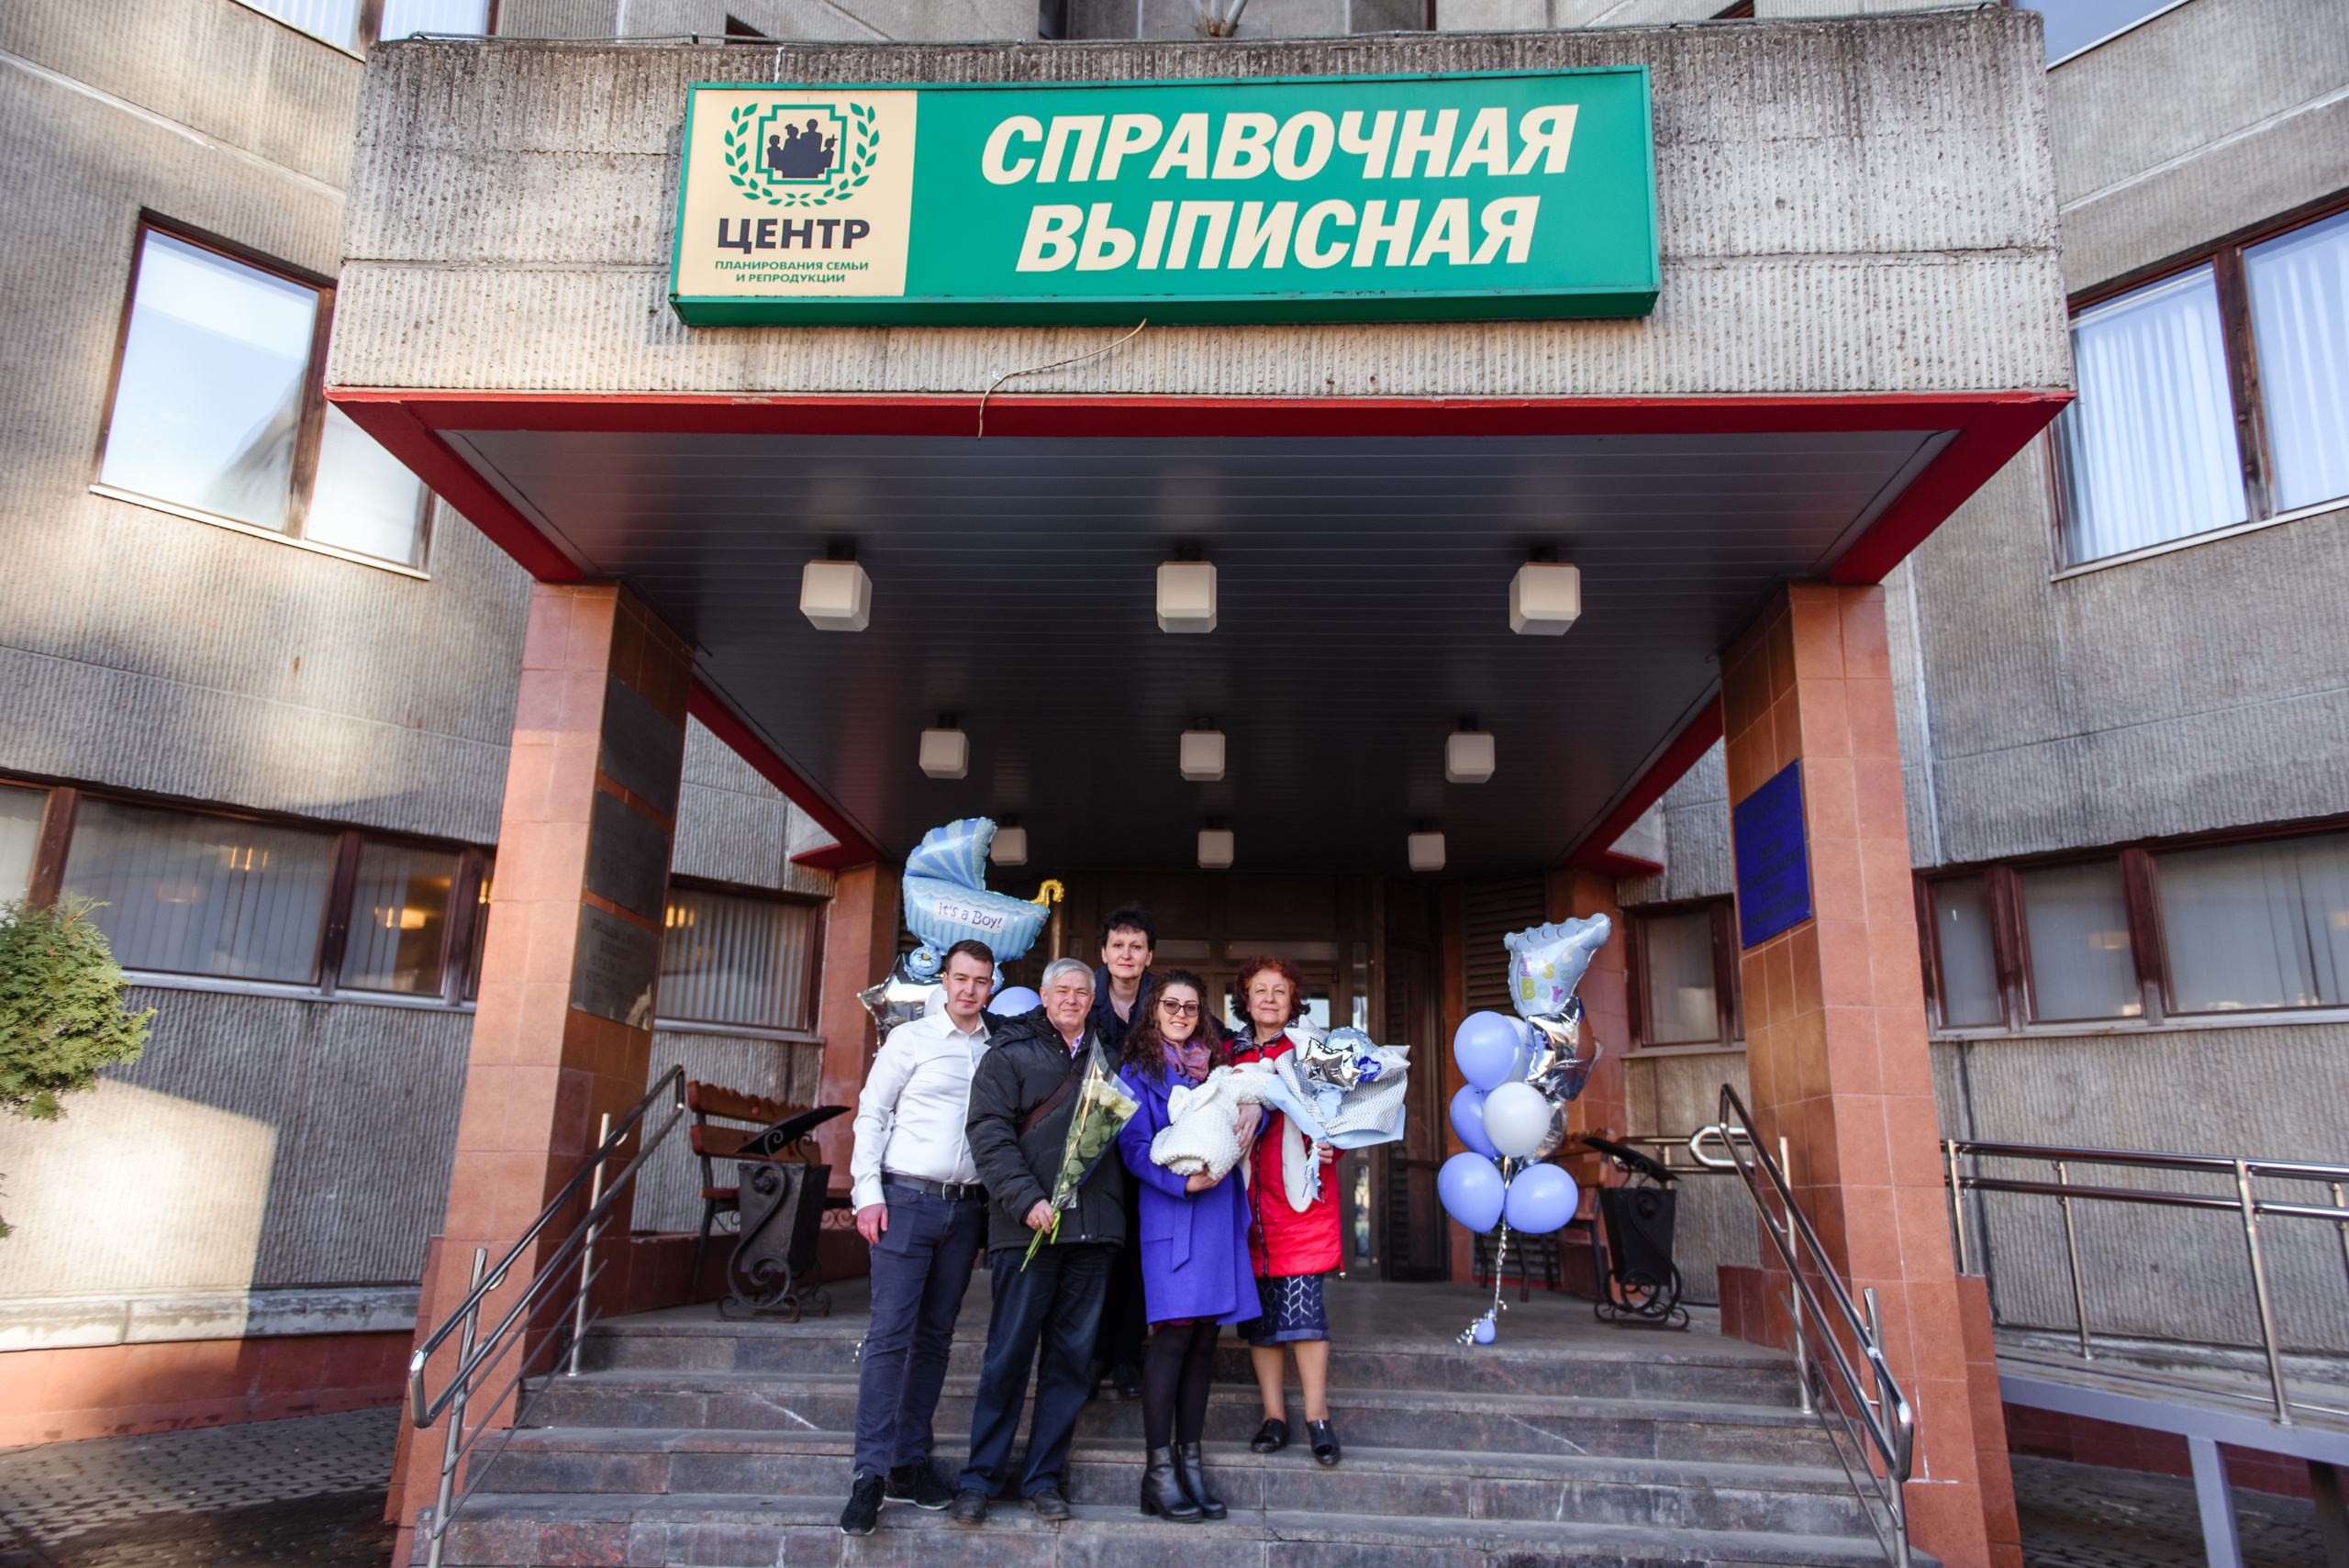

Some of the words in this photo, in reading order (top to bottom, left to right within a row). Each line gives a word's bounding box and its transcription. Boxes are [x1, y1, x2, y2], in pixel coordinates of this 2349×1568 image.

[981, 104, 1579, 185] СПРАВОЧНАЯ
[718, 217, 870, 254] ЦЕНТР
[1015, 195, 1541, 272] ВЫПИСНАЯ
[715, 261, 823, 271] ПЛАНИРОВАНИЯ
[826, 261, 869, 271] СЕМЬИ
[736, 273, 745, 283] И
[748, 273, 845, 284] РЕПРОДУКЦИИ
[939, 902, 959, 917] it's
[961, 909, 969, 921] a
[972, 910, 1002, 929] Boy!
